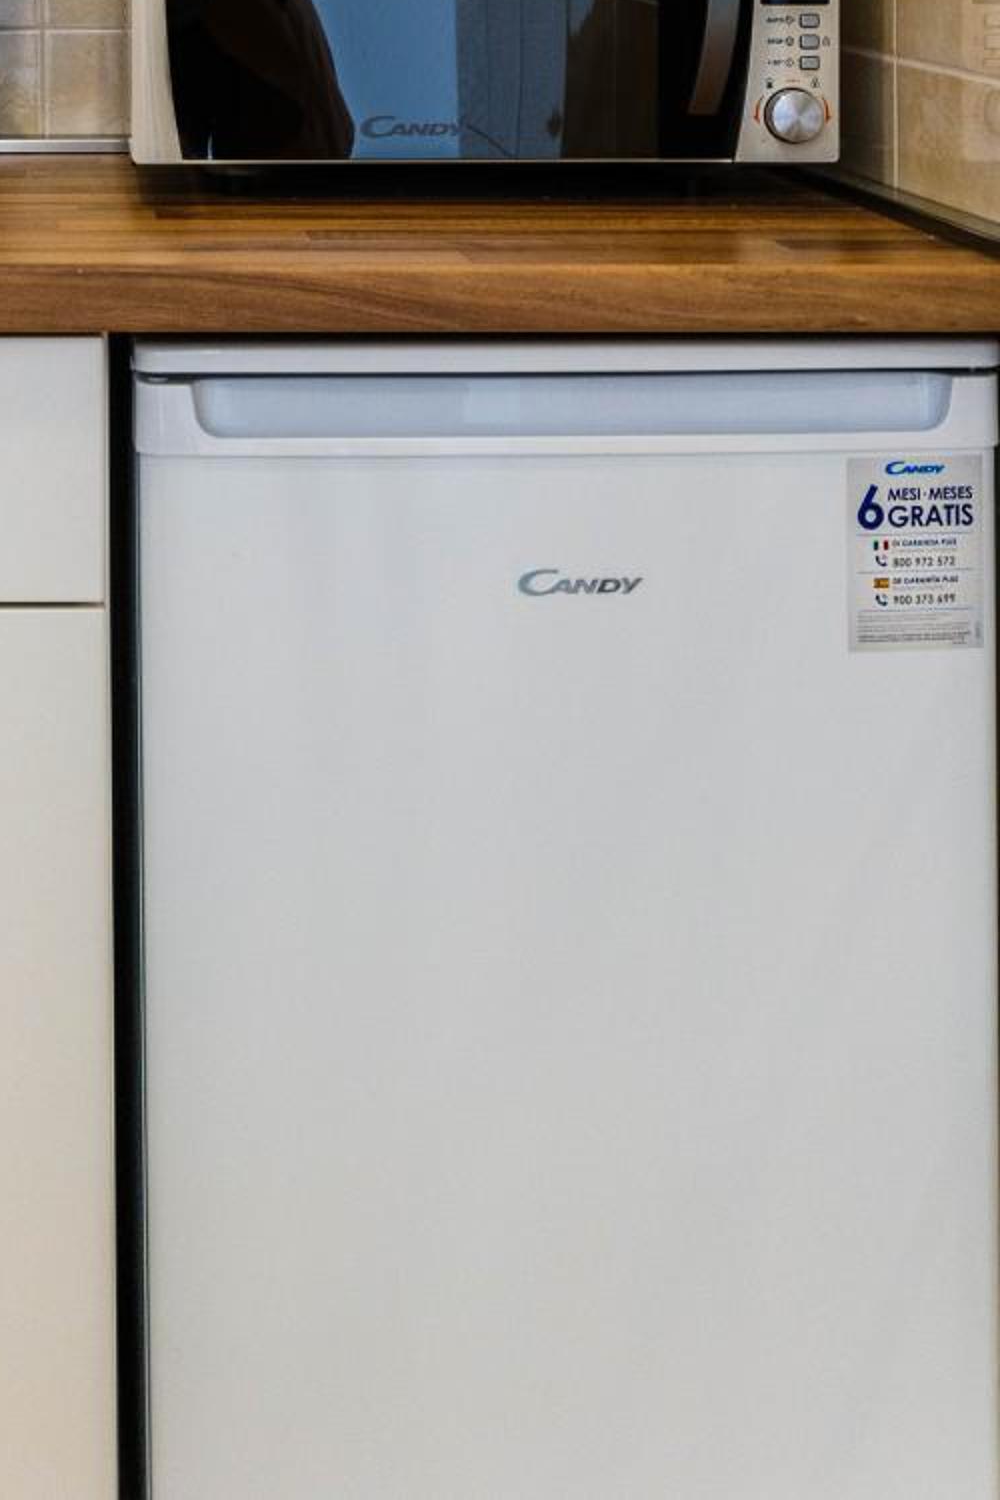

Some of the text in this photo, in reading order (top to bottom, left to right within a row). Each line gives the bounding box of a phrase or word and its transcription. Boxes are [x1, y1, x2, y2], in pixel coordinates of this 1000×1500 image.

[360, 115, 463, 138] CANDY
[887, 485, 973, 501] MESI MESES
[858, 484, 884, 530] 6
[888, 503, 973, 528] GRATIS
[915, 556, 933, 567] 972
[937, 555, 956, 566] 572
[517, 568, 644, 596] CANDY
